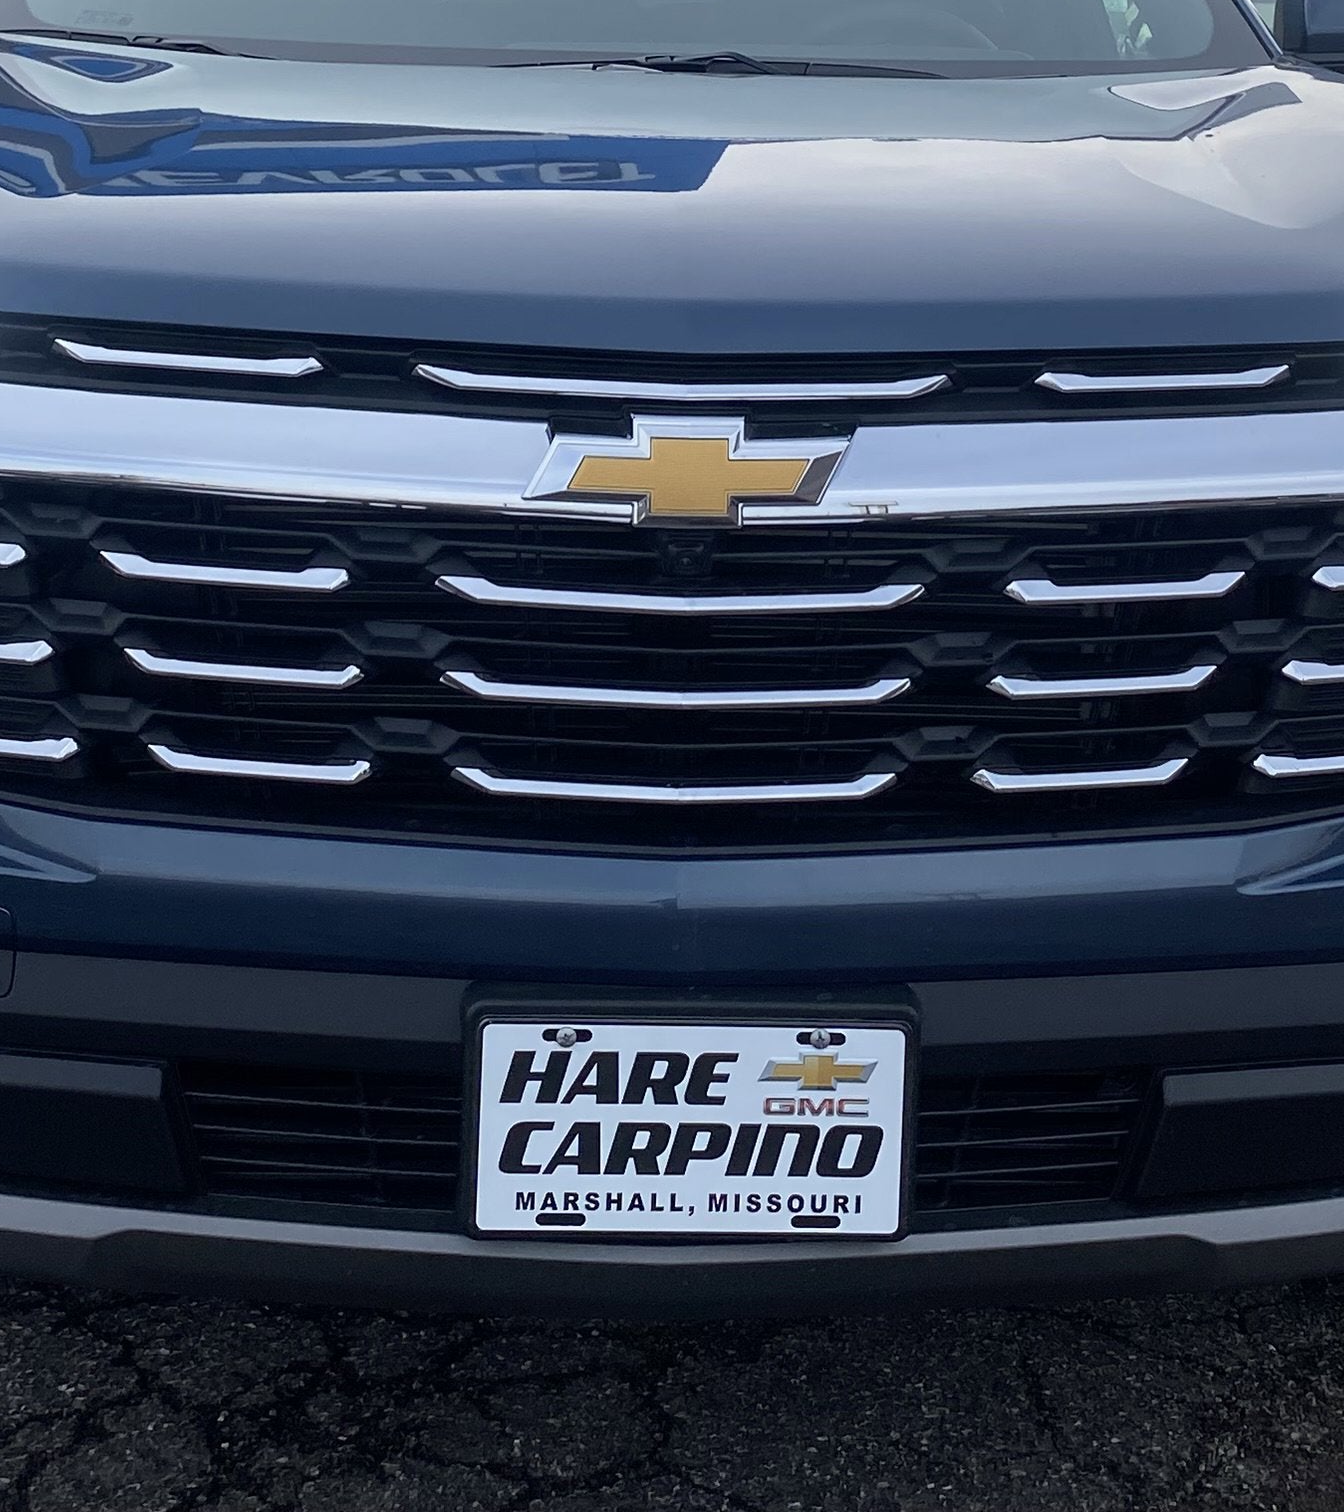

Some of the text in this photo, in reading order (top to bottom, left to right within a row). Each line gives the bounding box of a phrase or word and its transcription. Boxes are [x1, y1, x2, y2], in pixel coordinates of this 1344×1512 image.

[499, 1050, 739, 1106] HARE
[763, 1096, 870, 1118] GMC
[498, 1120, 884, 1178] CARPINO
[515, 1191, 862, 1216] MARSHALL, MISSOURI
